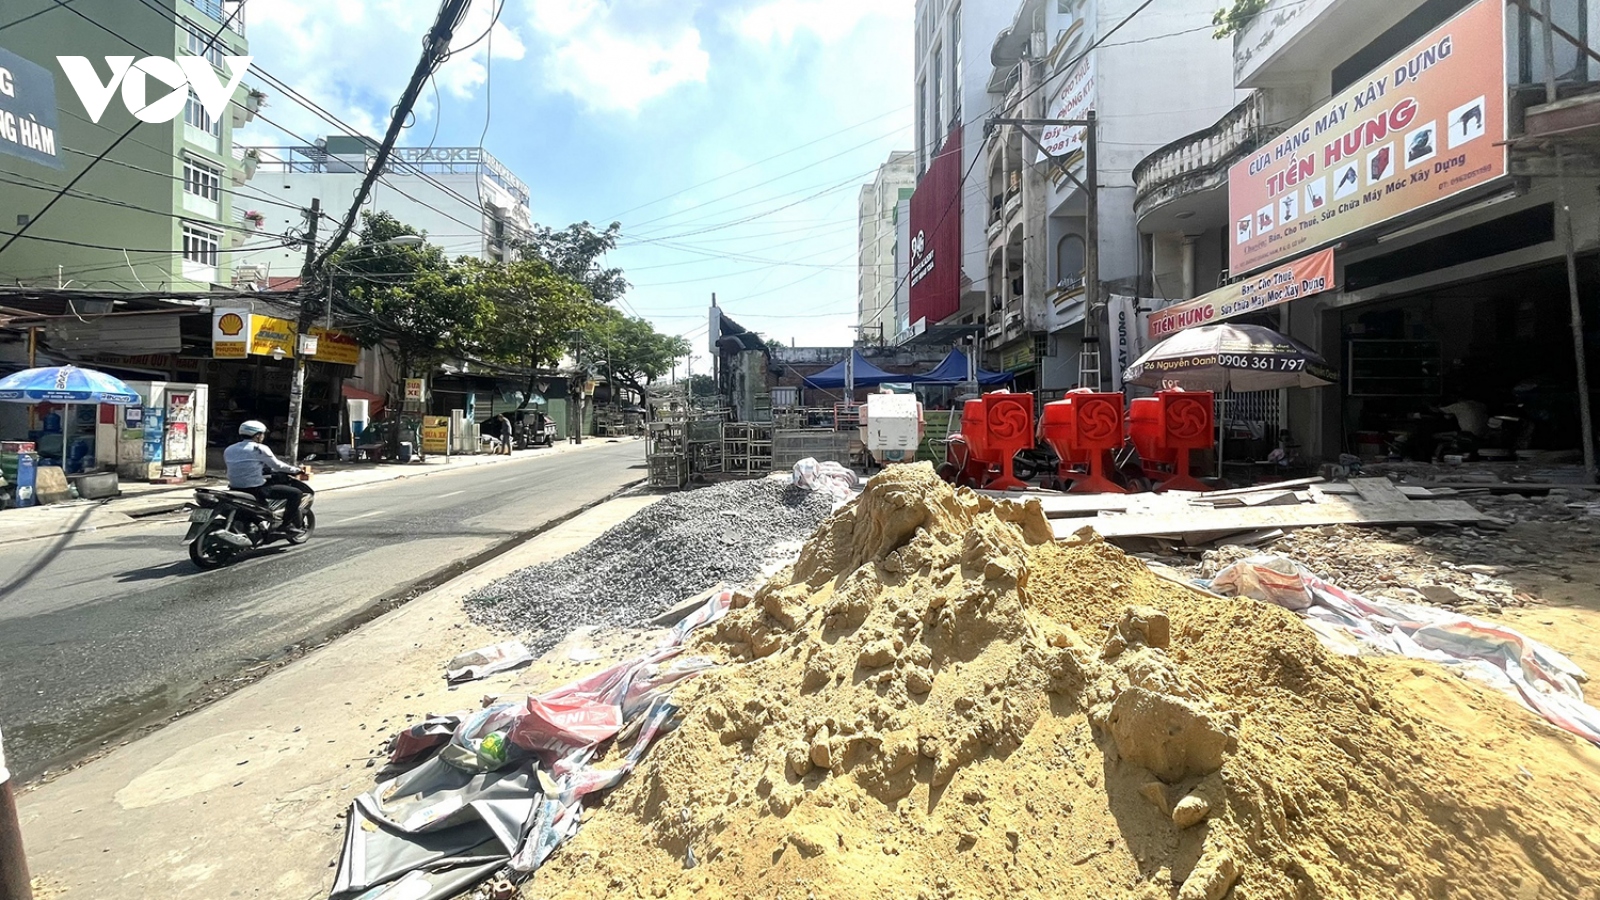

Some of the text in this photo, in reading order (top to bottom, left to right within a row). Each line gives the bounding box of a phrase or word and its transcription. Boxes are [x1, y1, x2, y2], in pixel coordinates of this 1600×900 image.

[1249, 35, 1452, 176] CỬA HÀNG MÁY XÂY DỰNG
[19, 112, 56, 155] HÀM
[1266, 97, 1418, 198] TIẾN HƯNG
[386, 148, 480, 161] ARAOKE
[1284, 226, 1297, 237] Cho
[1338, 198, 1360, 214] Chữa
[1363, 189, 1382, 204] Máy
[1385, 180, 1407, 195] Móc
[1410, 168, 1430, 185] Xây
[1434, 154, 1466, 174] Dựng
[1178, 304, 1214, 329] HƯNG
[1191, 356, 1217, 365] Oanh
[1218, 354, 1306, 371] 0906 361 797
